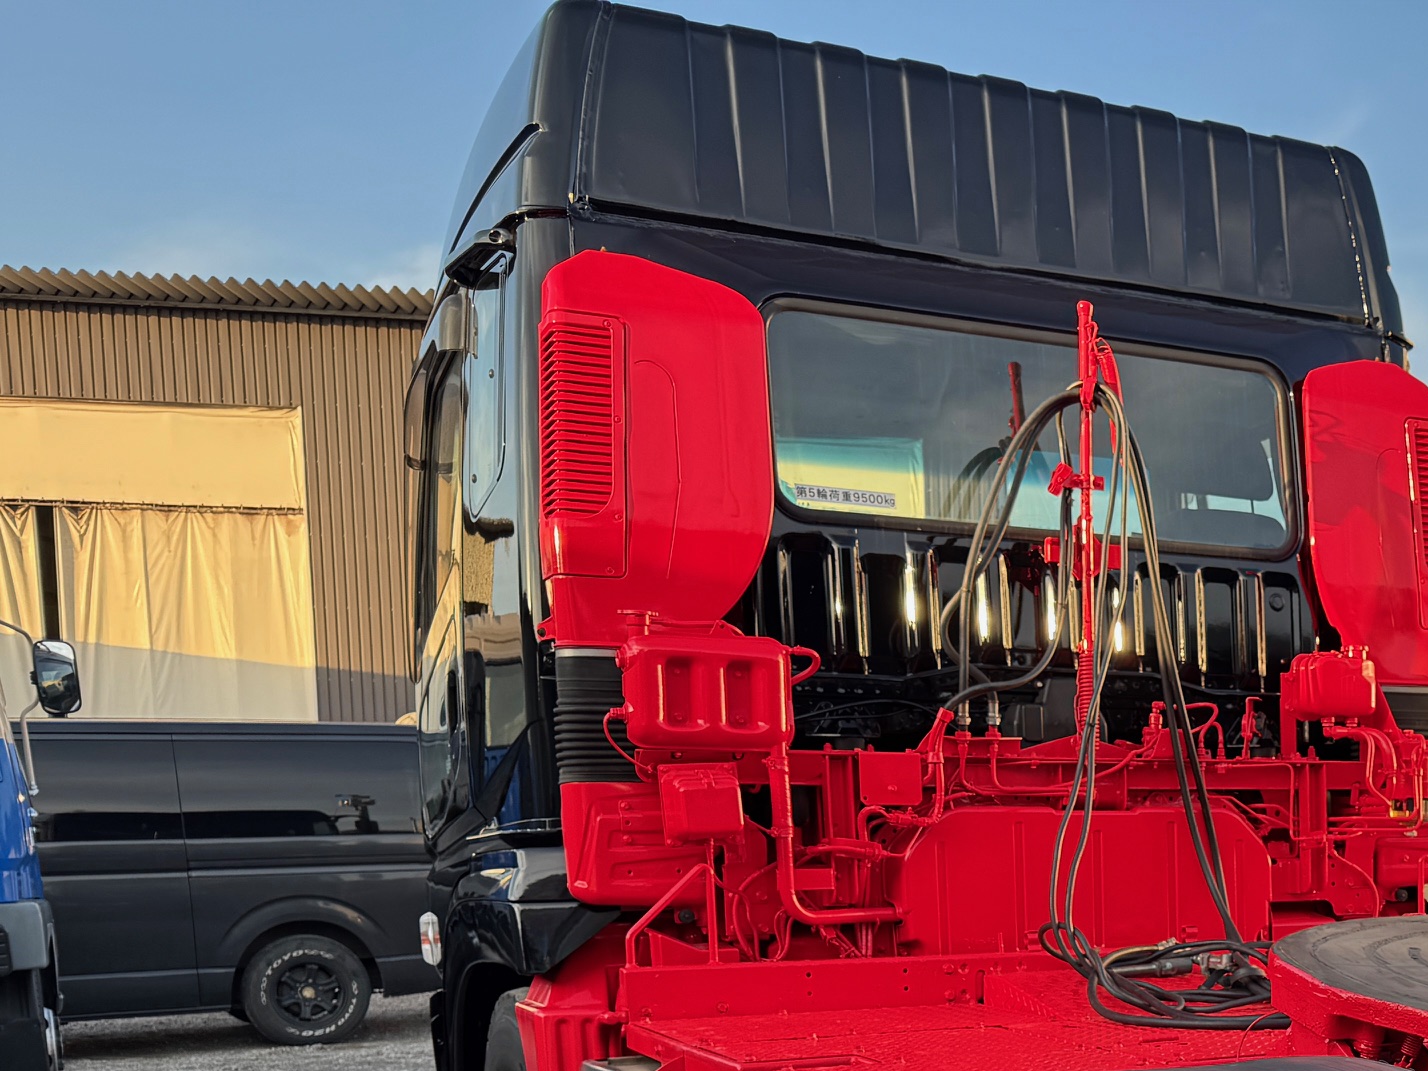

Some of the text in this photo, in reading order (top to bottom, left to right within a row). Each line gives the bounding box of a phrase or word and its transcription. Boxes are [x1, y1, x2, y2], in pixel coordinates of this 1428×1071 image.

[796, 486, 896, 507] 第5輪荷重9500kg
[265, 949, 304, 976] TOYO
